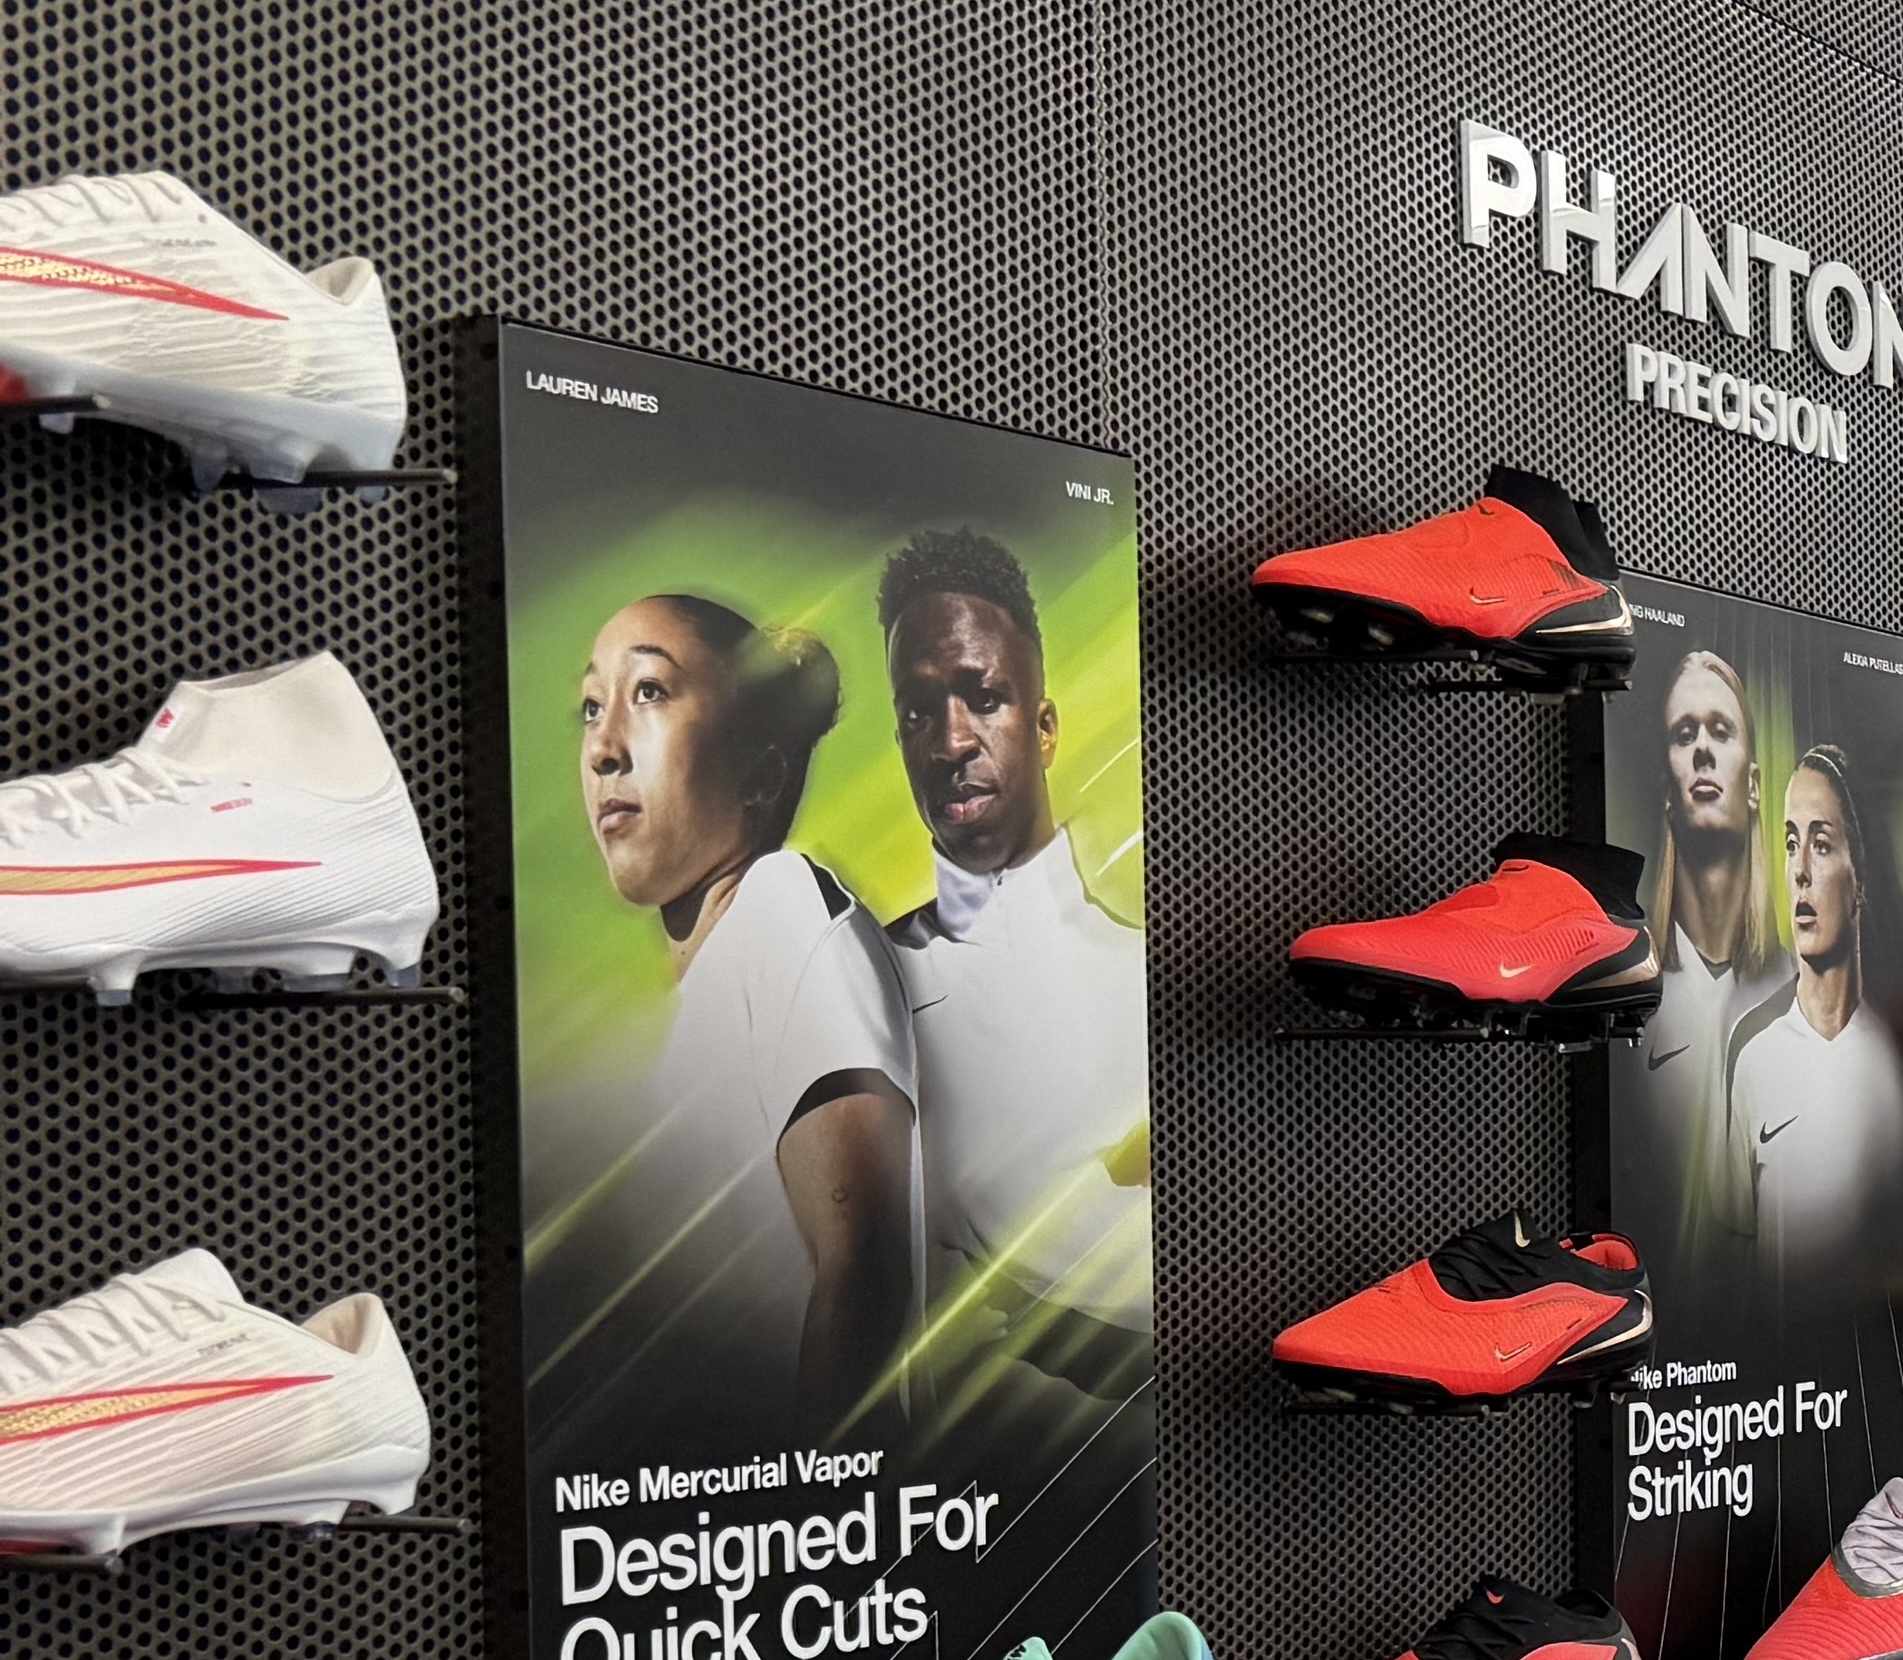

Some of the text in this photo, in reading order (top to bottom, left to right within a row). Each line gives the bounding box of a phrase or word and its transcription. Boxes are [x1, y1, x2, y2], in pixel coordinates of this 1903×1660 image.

[526, 370, 659, 414] LAUREN JAMES
[1625, 341, 1848, 464] PRECISION
[1065, 481, 1114, 505] VINI JR.
[1644, 602, 1685, 628] HAALAND
[1667, 1360, 1737, 1387] Phantom
[1628, 1381, 1848, 1461] Designed For
[555, 1449, 884, 1512] Nike Mercurial Vapor
[1627, 1457, 1753, 1522] Striking
[561, 1484, 999, 1605] Designed For
[781, 1578, 928, 1660] Cuts
